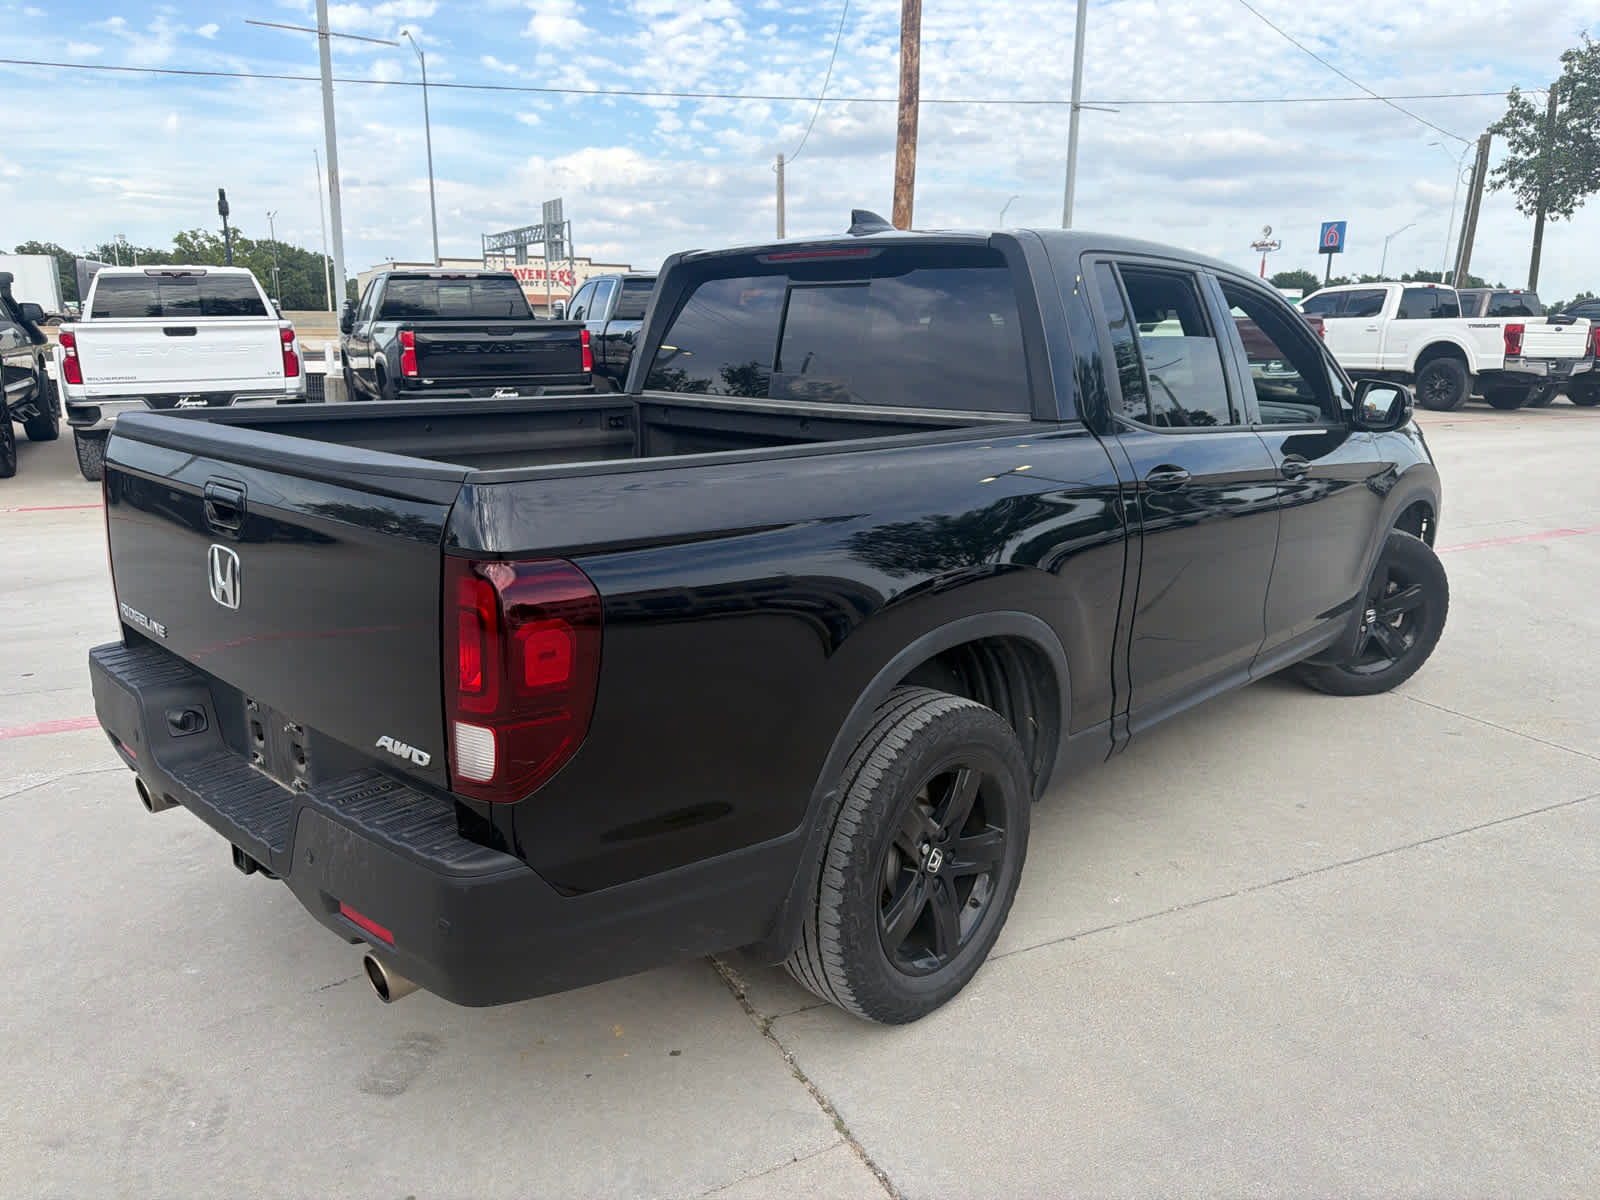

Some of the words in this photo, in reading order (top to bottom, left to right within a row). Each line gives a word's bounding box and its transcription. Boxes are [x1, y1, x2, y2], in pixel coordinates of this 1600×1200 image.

[1325, 223, 1339, 246] 6
[120, 602, 168, 639] RIDGELINE
[376, 735, 431, 767] AWD
